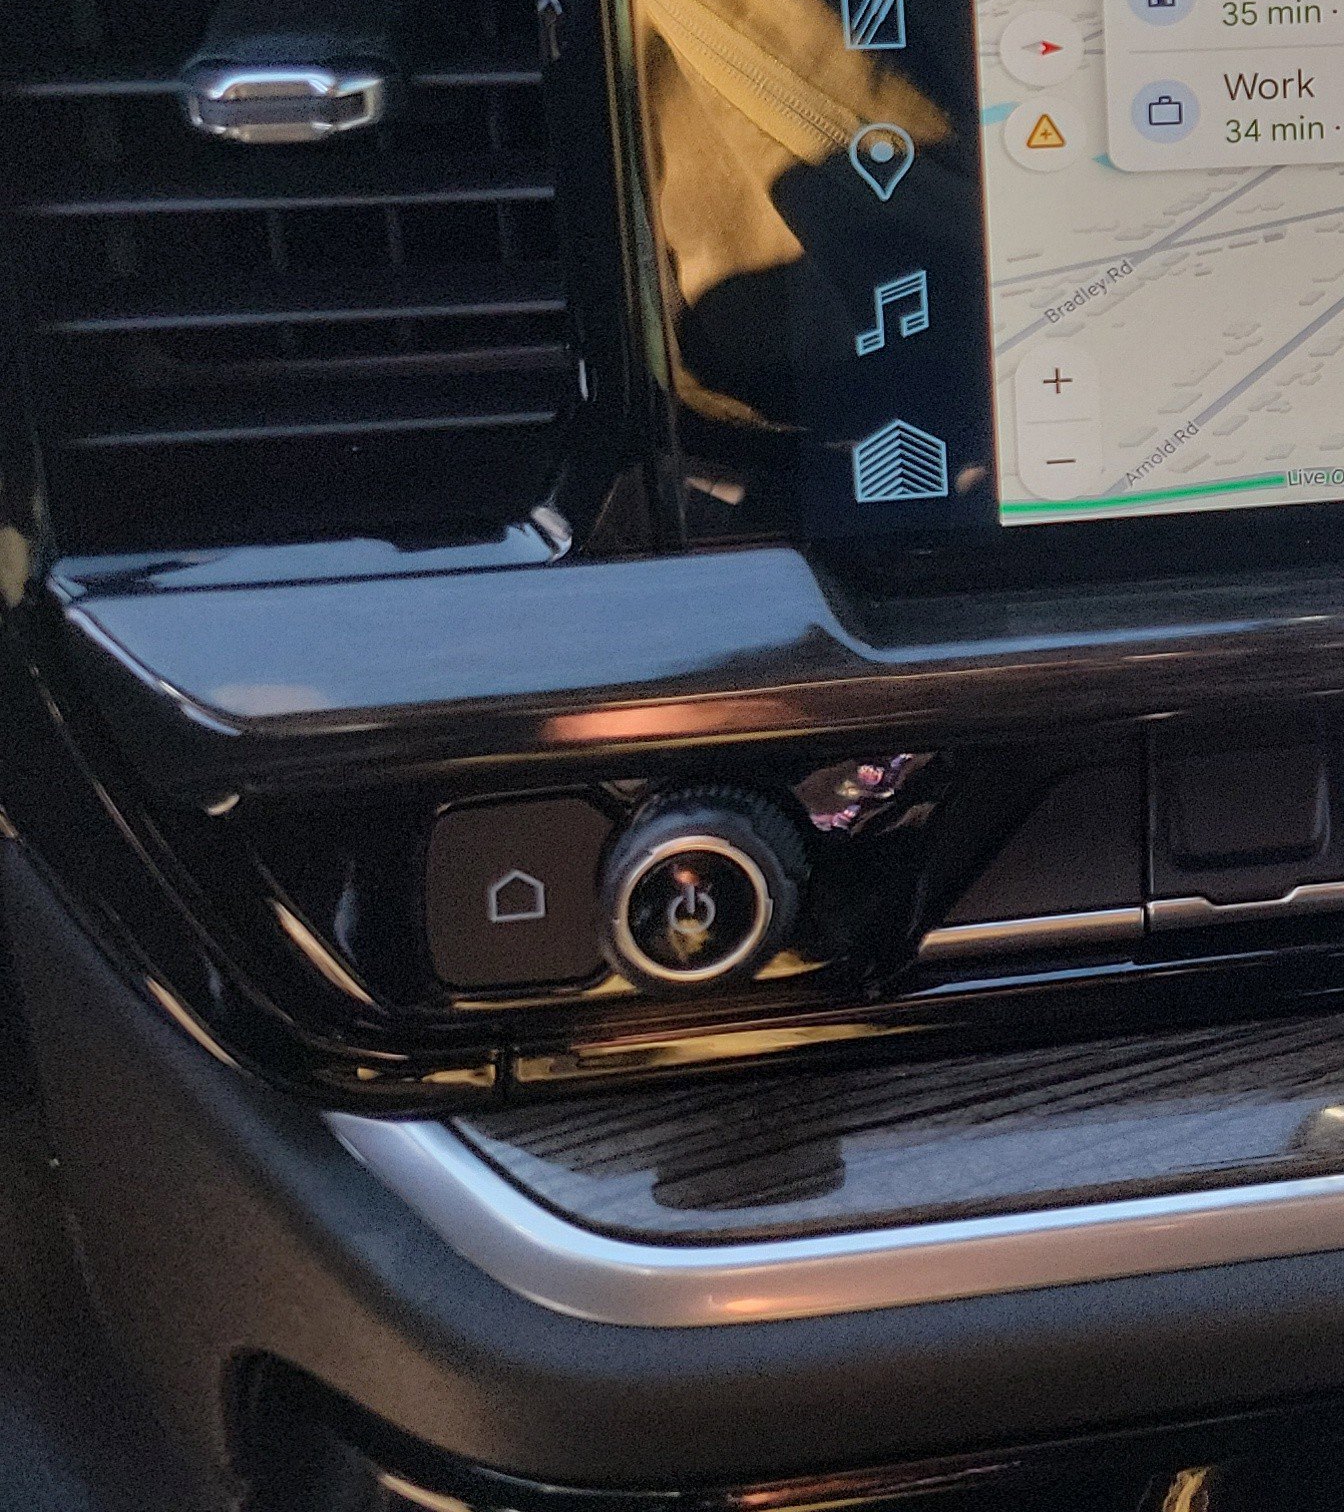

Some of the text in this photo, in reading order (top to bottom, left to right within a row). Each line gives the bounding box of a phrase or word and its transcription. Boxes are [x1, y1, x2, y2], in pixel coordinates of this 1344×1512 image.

[1221, 1, 1258, 27] 35
[1222, 69, 1316, 101] Work
[1224, 117, 1262, 144] 34
[1270, 115, 1326, 142] min
[1043, 259, 1134, 325] Bradley Rd
[1124, 421, 1201, 488] Arnold Rd
[1287, 469, 1326, 487] Live
